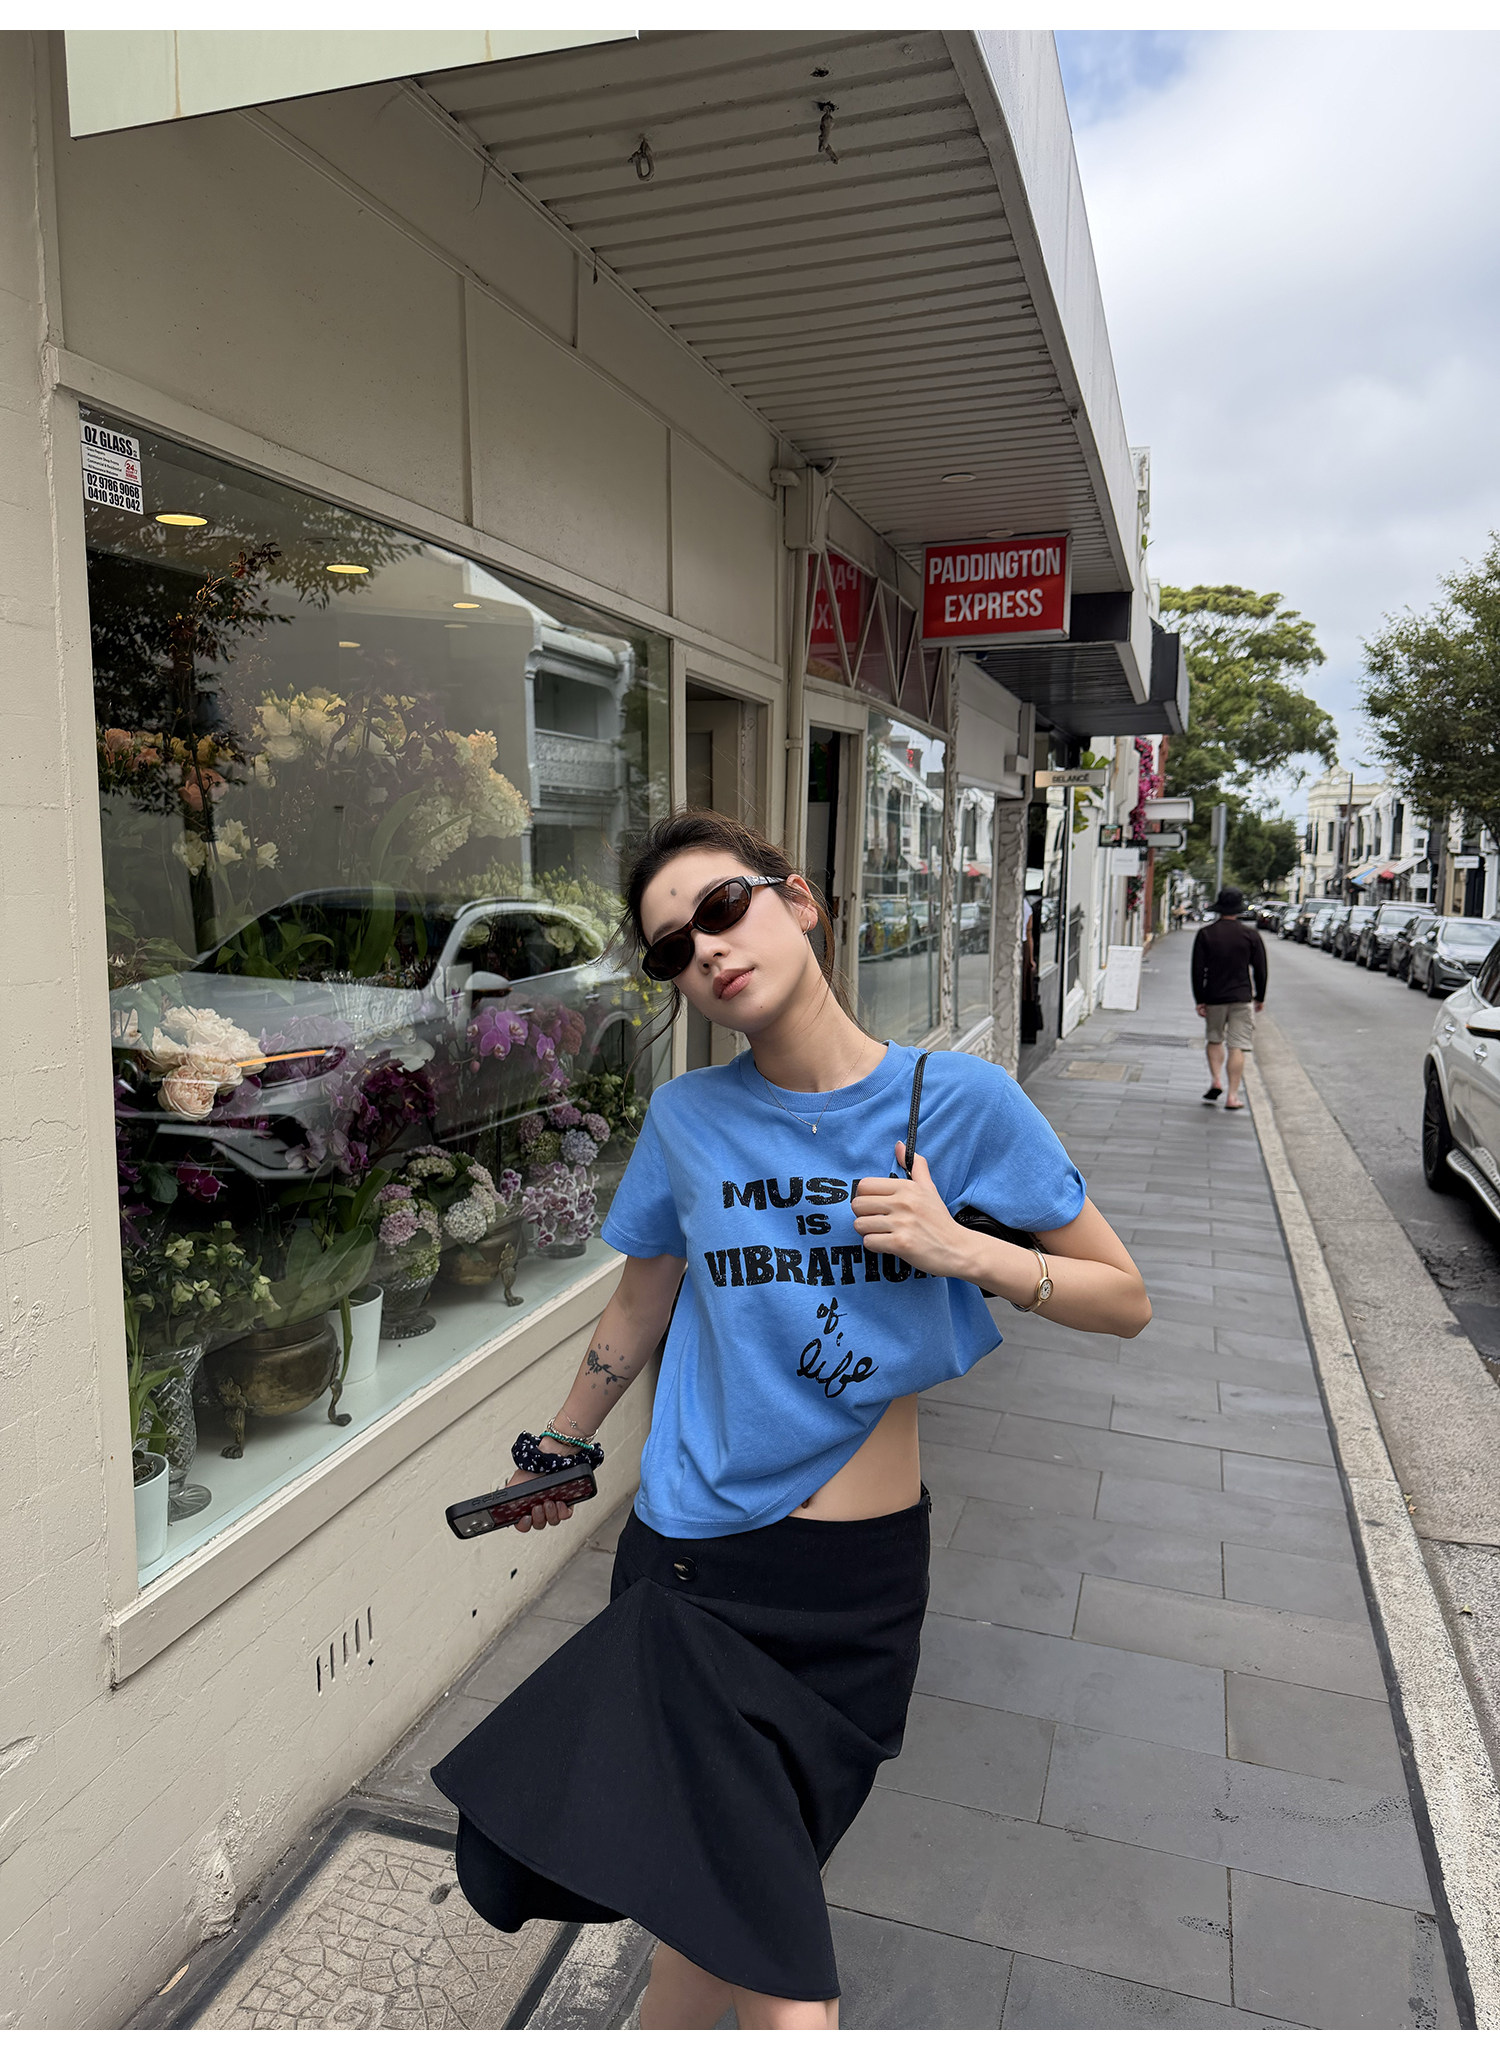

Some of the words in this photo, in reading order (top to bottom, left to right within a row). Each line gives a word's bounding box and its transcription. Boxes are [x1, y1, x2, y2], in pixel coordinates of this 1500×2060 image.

[84, 425, 97, 444] OZ
[100, 430, 132, 456] GLASS
[87, 472, 97, 487] 02
[98, 476, 118, 492] 9786
[120, 482, 140, 499] 9068
[88, 486, 107, 502] 0410
[108, 492, 124, 508] 392
[126, 497, 140, 512] 042
[929, 547, 1061, 585] PADDINGTON
[944, 588, 1043, 623] EXPRESS
[796, 1213, 831, 1235] IS
[704, 1244, 940, 1288] VIBRATIO
[816, 1297, 848, 1335] of
